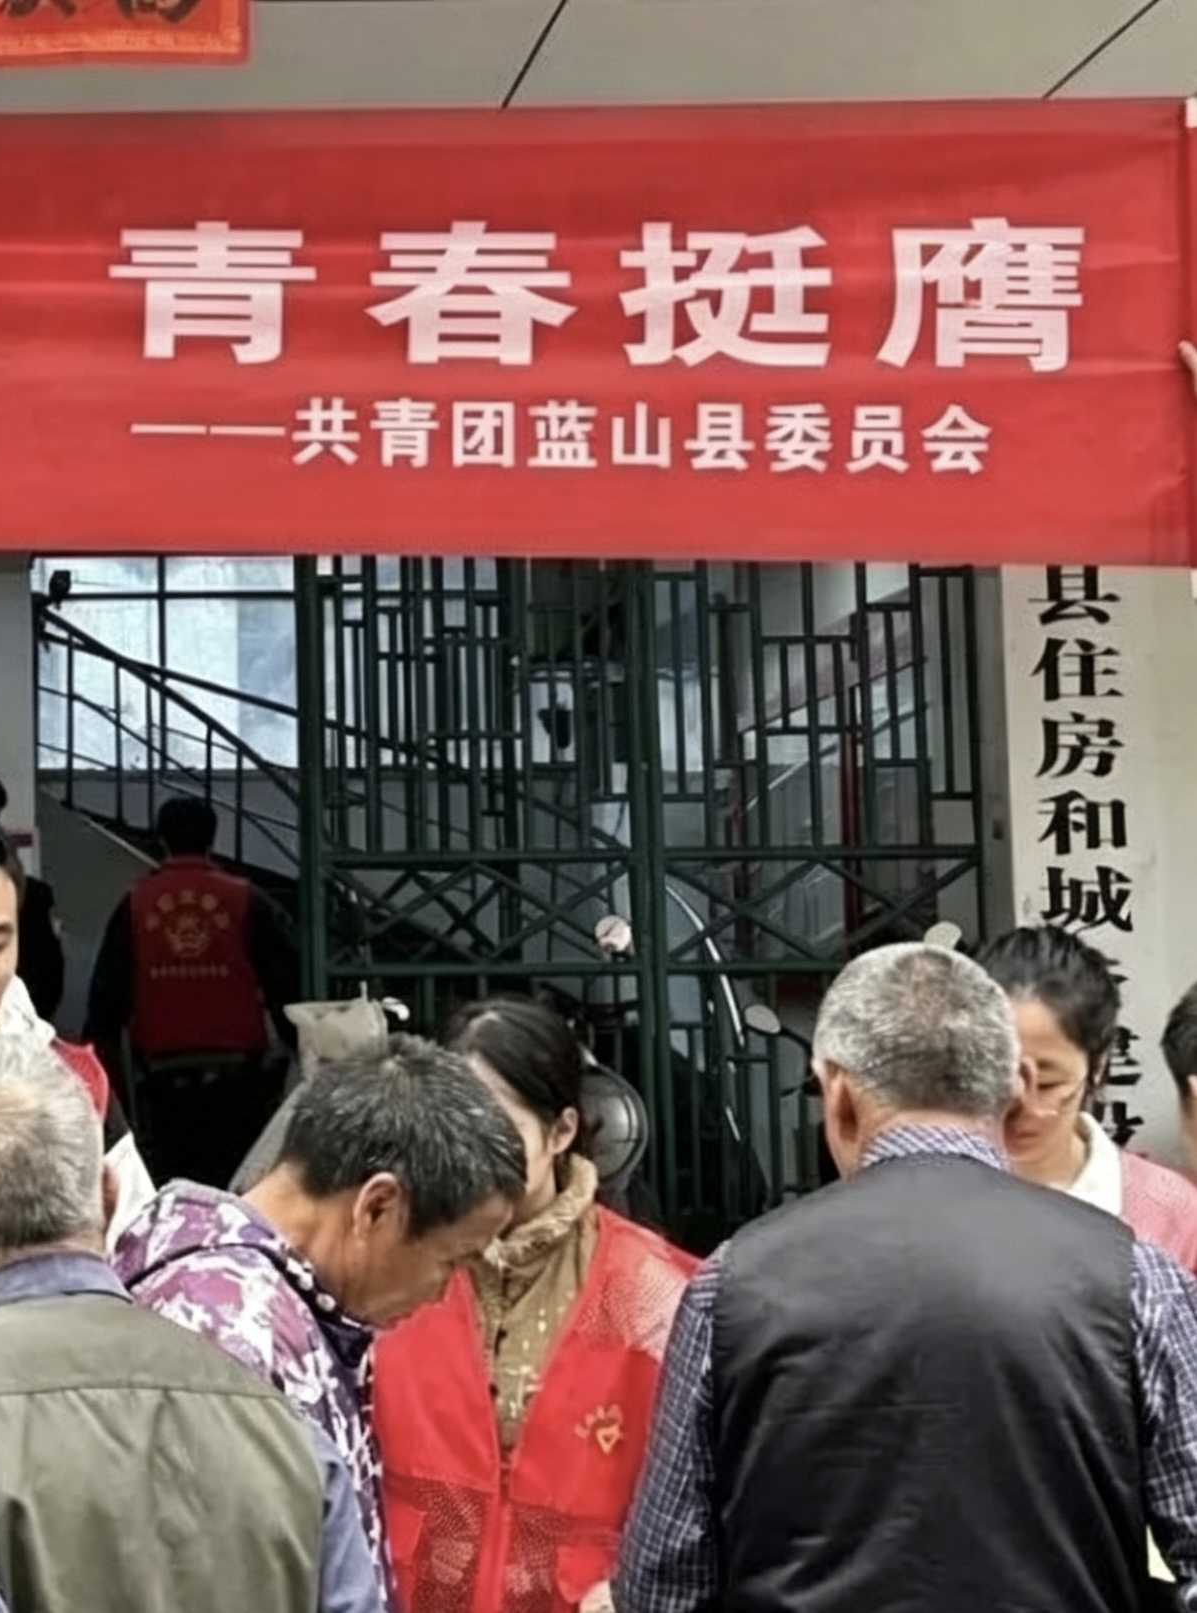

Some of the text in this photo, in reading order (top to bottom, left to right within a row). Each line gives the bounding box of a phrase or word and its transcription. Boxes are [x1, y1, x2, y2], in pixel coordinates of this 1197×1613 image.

[109, 217, 1085, 373] 青春挺膺
[1028, 564, 1144, 1147] 县住房和城
